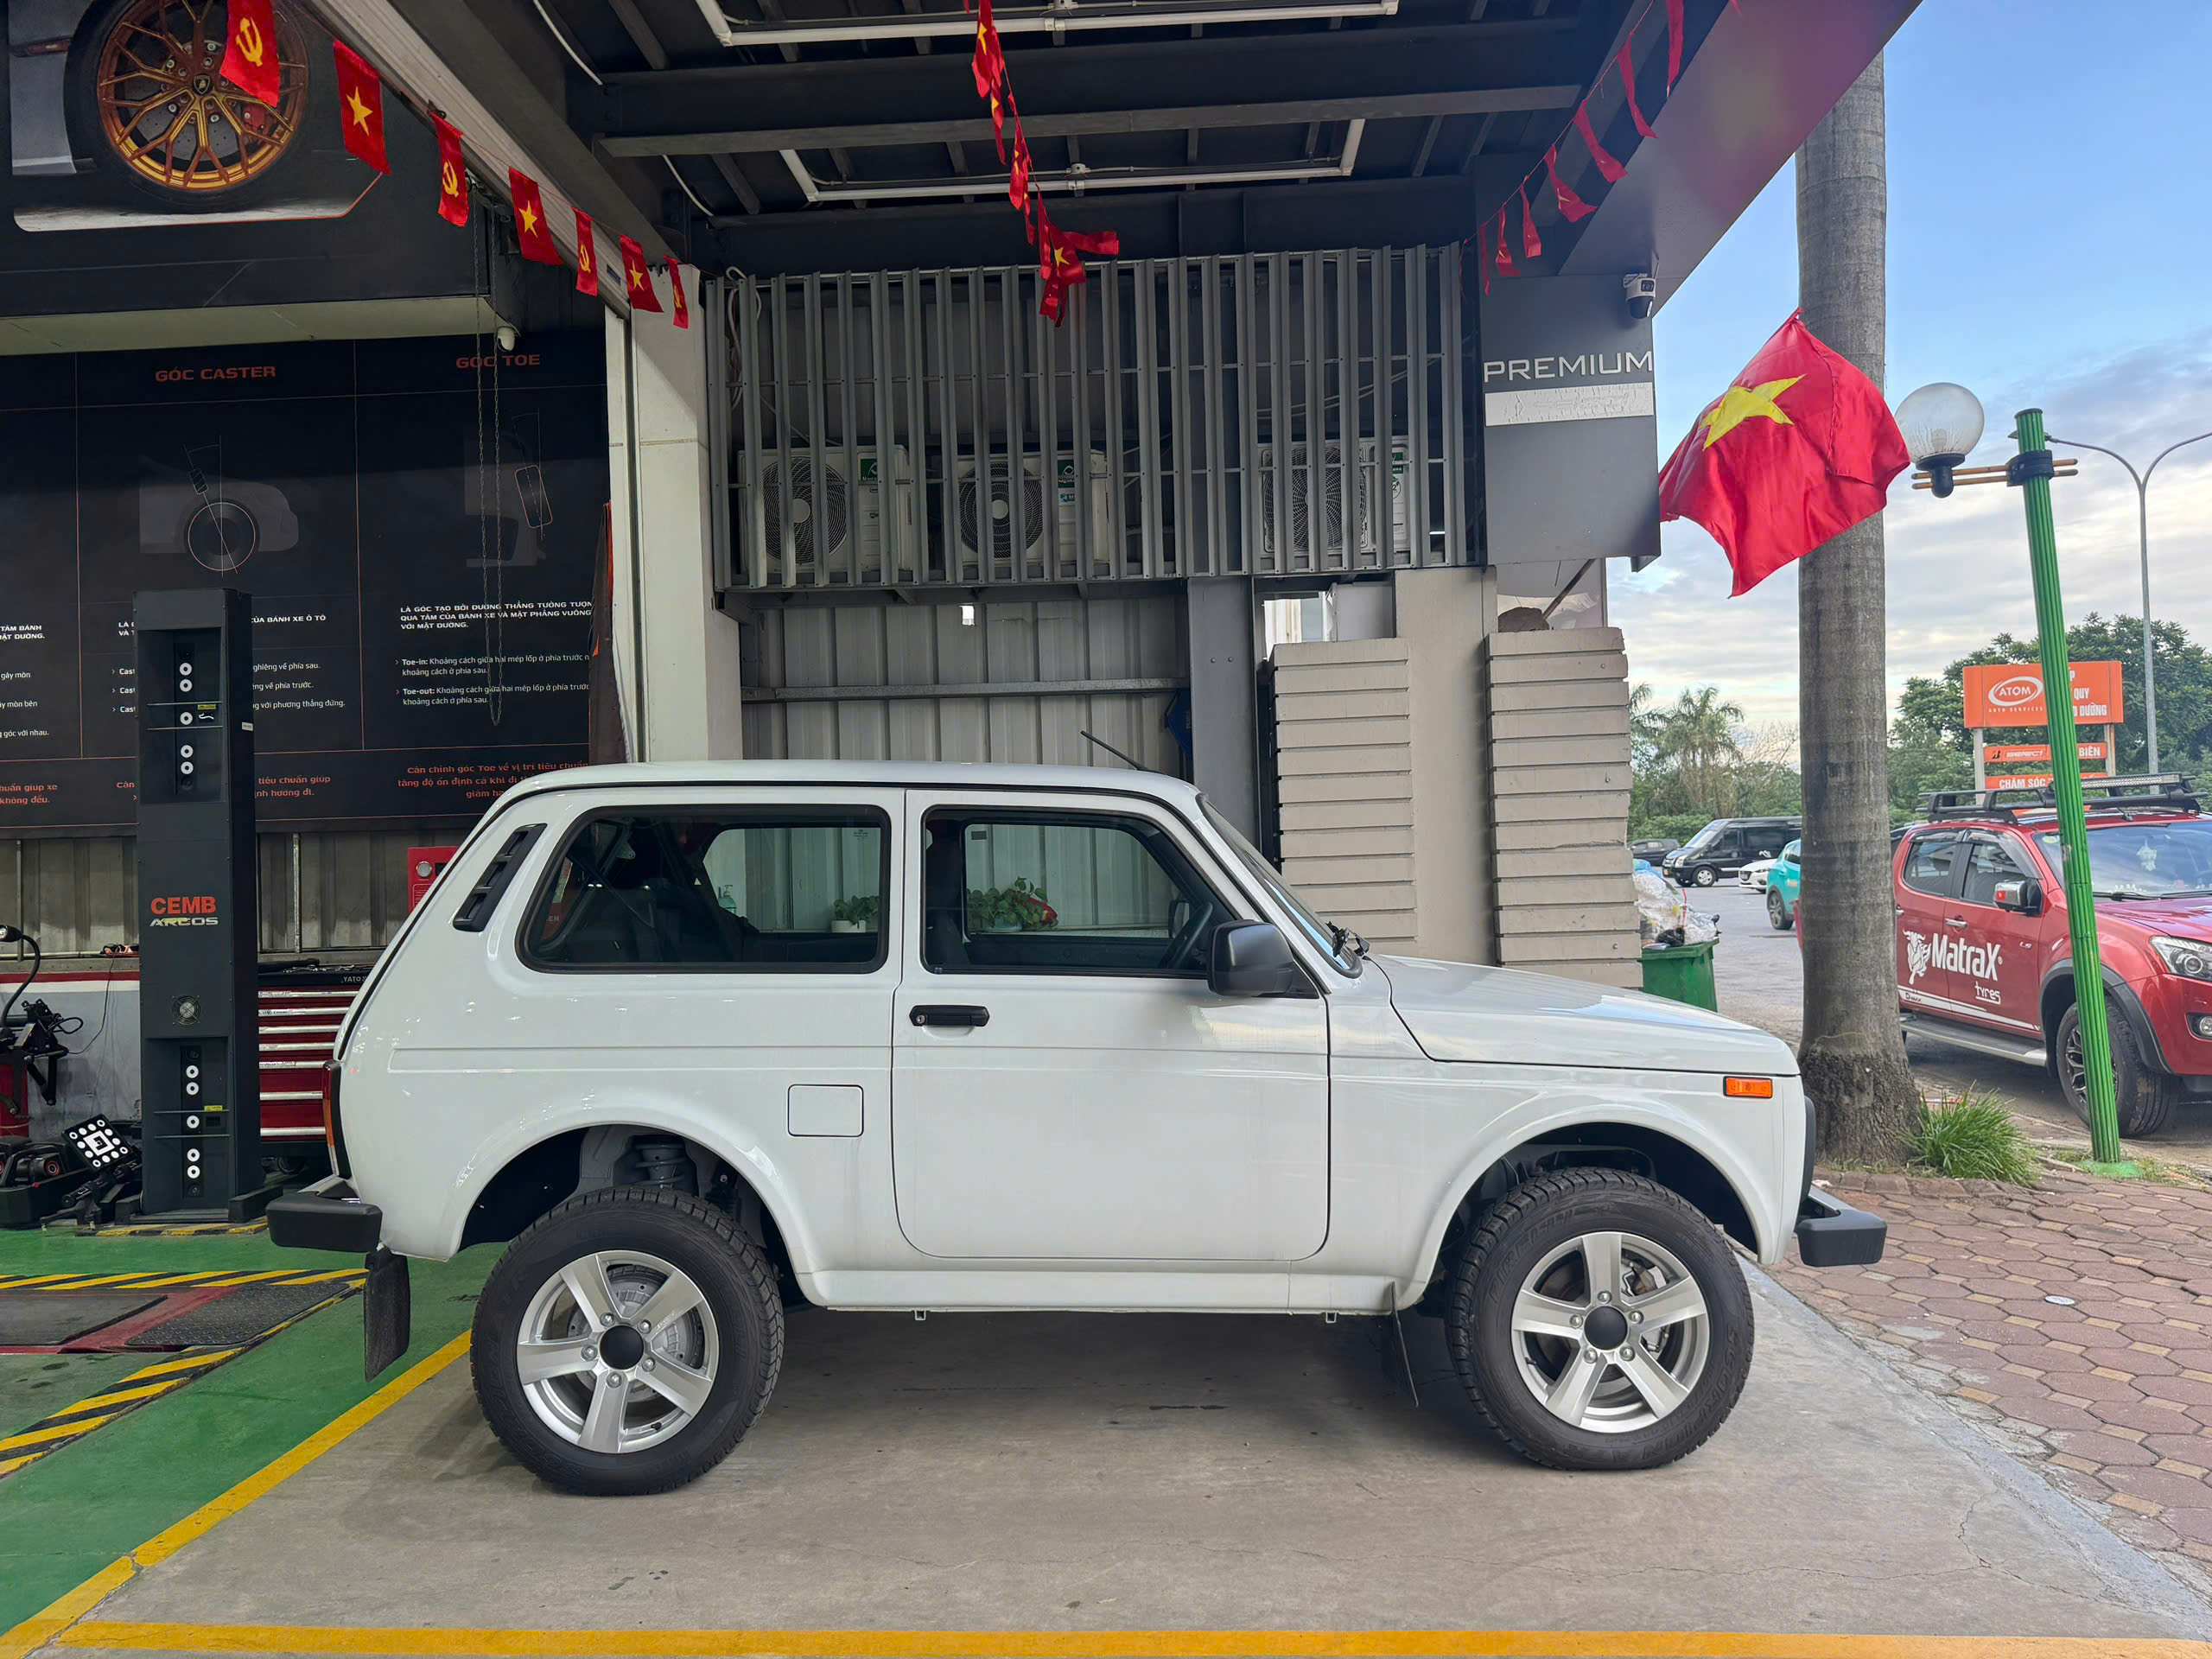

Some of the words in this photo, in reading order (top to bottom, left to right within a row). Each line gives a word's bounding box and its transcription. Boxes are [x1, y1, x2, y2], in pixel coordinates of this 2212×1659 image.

[502, 354, 540, 366] TOE
[1484, 351, 1653, 383] PREMIUM
[155, 366, 194, 382] GÓC
[200, 366, 276, 380] CASTER
[458, 611, 482, 620] BÁNH
[429, 656, 457, 667] Khoảng
[459, 655, 475, 664] cách
[495, 654, 506, 663] hai
[507, 653, 524, 664] mép
[545, 652, 562, 663] phía
[288, 662, 304, 671] phía
[402, 668, 429, 677] khoảng
[430, 666, 448, 676] cách
[455, 665, 472, 676] phía
[473, 666, 488, 675] sau.
[275, 681, 290, 690] phía
[403, 686, 435, 696] Toe-out:
[436, 685, 465, 696] Khoảng
[465, 684, 483, 694] cách
[501, 683, 514, 692] hai
[515, 683, 531, 693] mép
[552, 682, 568, 693] phía
[1999, 686, 2031, 696] ATOM
[2074, 688, 2089, 701] QUY
[403, 696, 430, 706] khoảng
[431, 696, 448, 705] cách
[456, 695, 473, 705] phía
[474, 696, 489, 704] sau.
[3, 729, 16, 739] góc
[2079, 746, 2101, 757] BIÊN
[457, 764, 474, 775] góc
[490, 775, 505, 784] khi
[2028, 776, 2046, 787] SÓC
[150, 896, 217, 914] CEMB
[1975, 982, 2000, 1003] tyres
